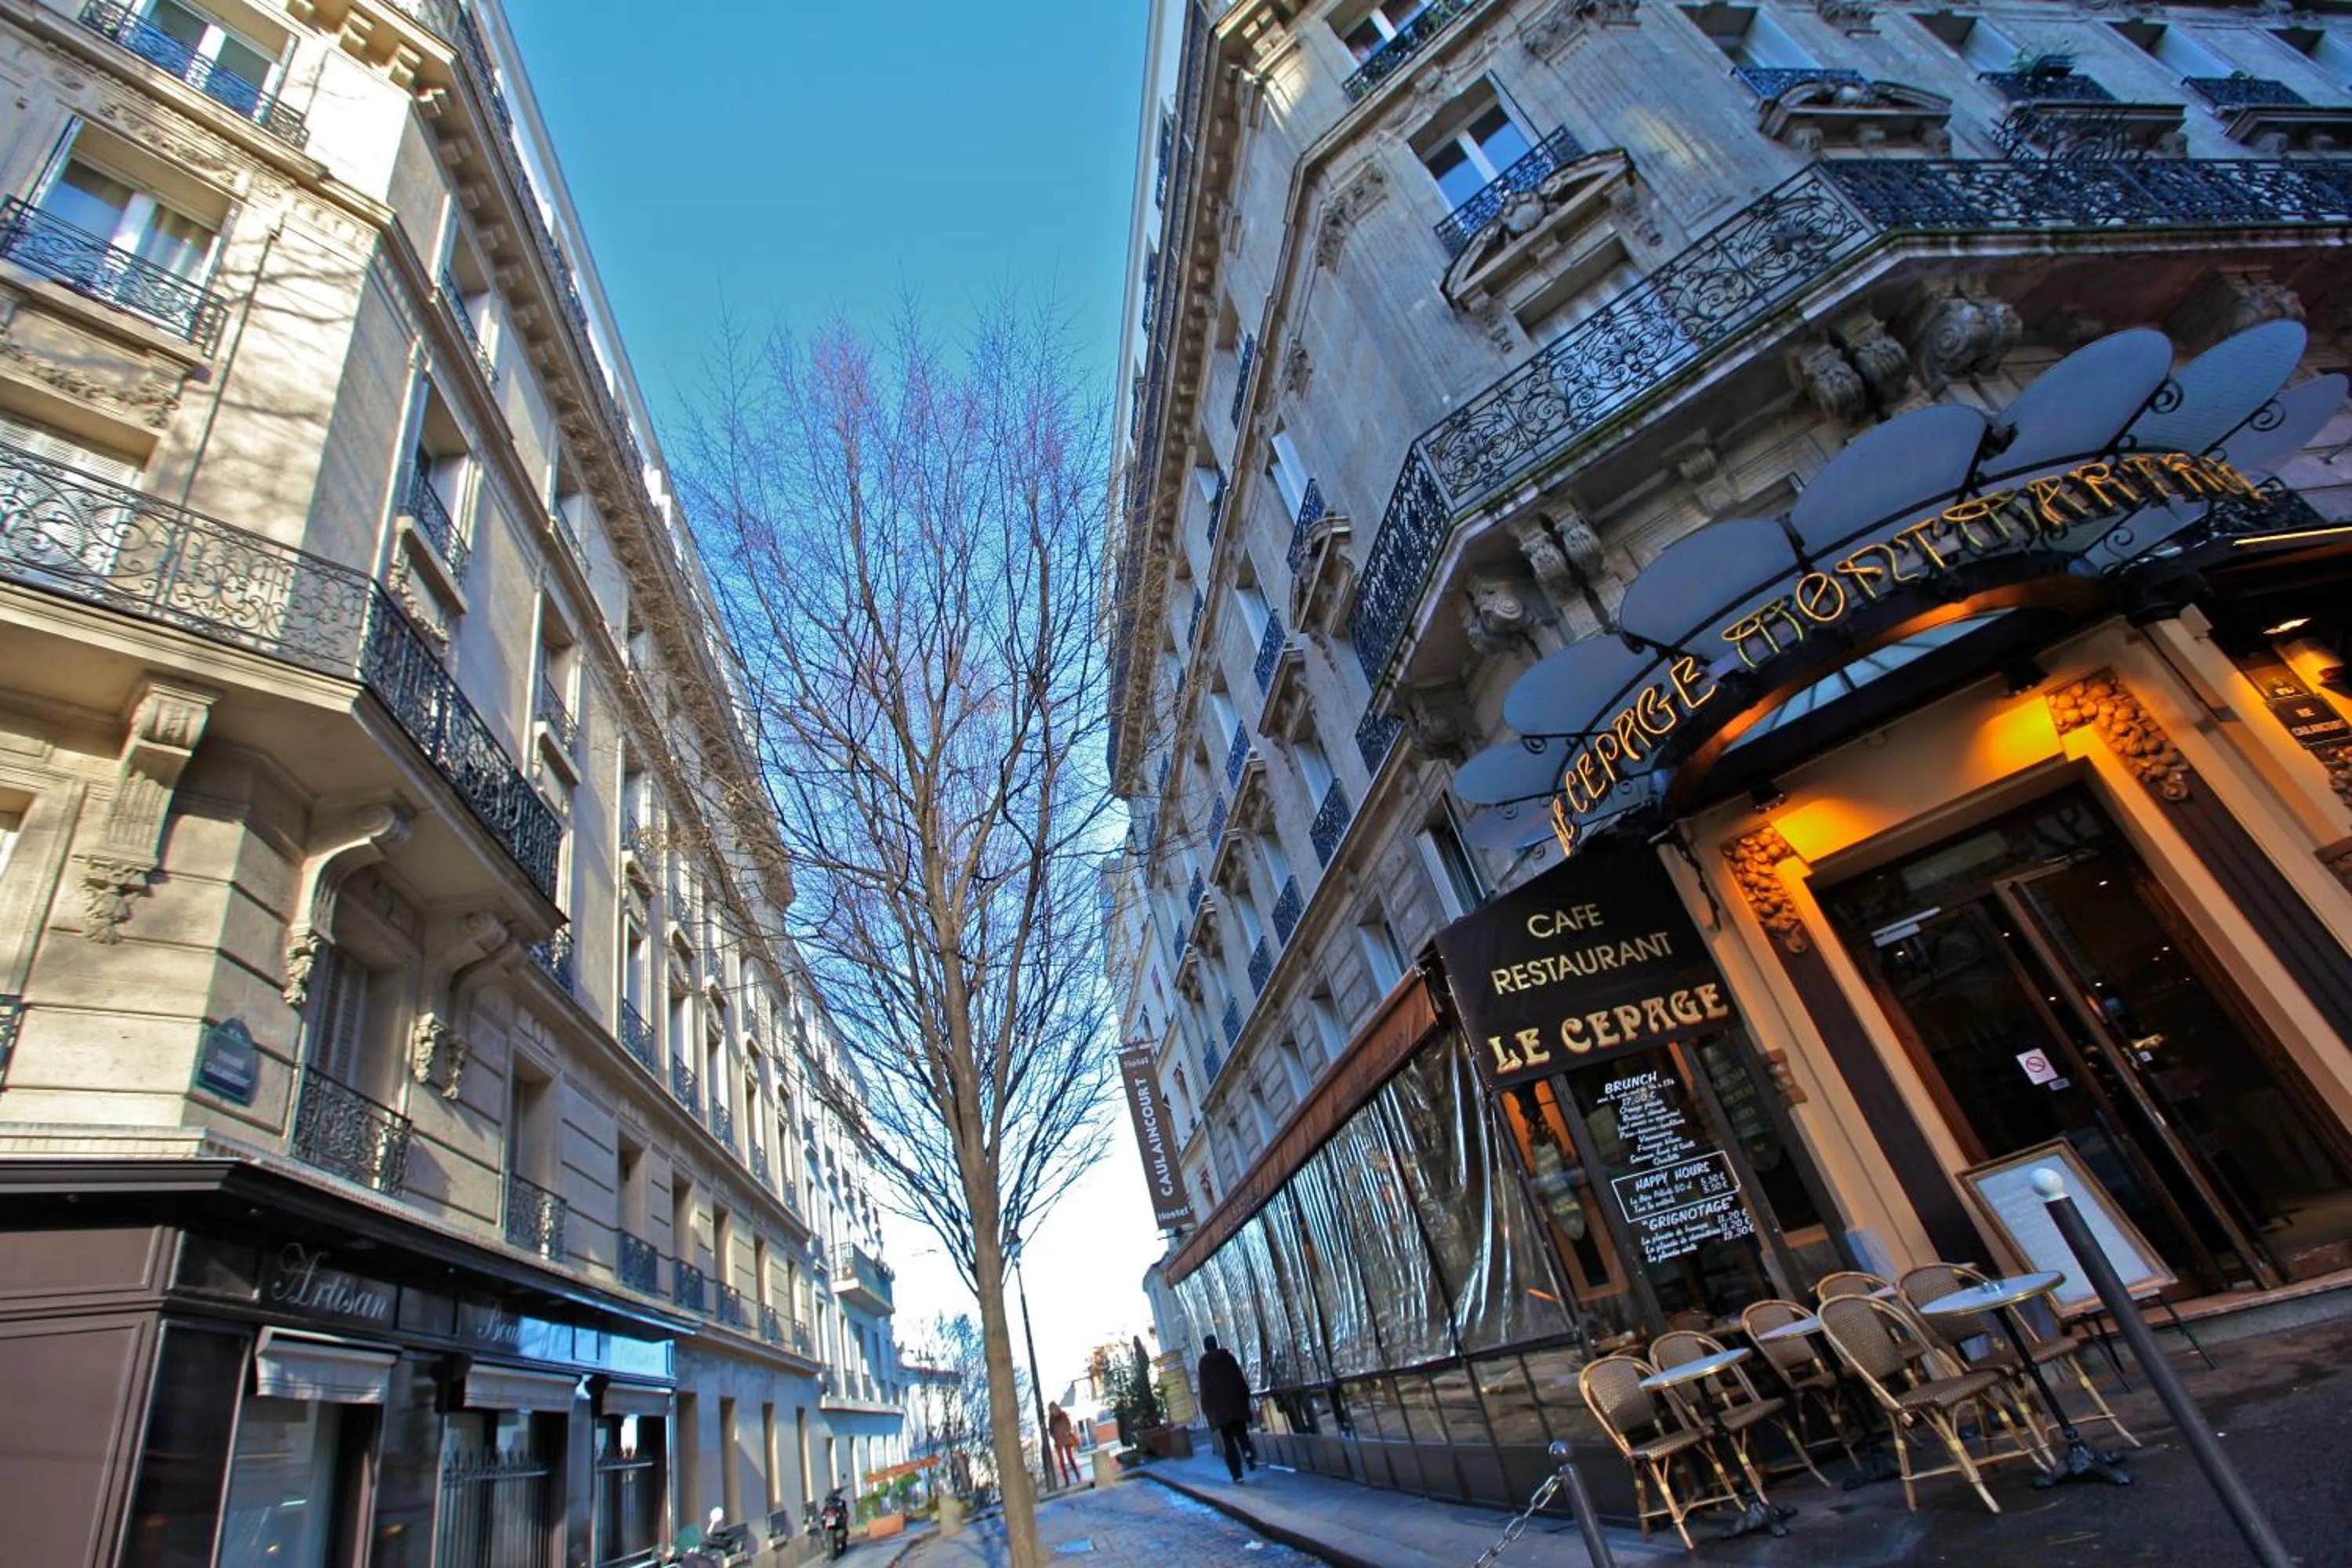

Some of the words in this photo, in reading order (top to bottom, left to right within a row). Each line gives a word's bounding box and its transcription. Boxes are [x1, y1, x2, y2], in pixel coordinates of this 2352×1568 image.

[1565, 655, 1718, 814] CEPAGE
[1526, 903, 1605, 940] CAFE
[1490, 931, 1674, 995] RESTAURANT
[1487, 1027, 1551, 1075] LE
[1560, 982, 1729, 1054] CEPAGE
[1605, 1071, 1657, 1094] BRUNCH
[1134, 1077, 1174, 1197] CAULAINCOURT
[1635, 1171, 1668, 1192] HAPPY
[272, 1242, 388, 1319] Artisan
